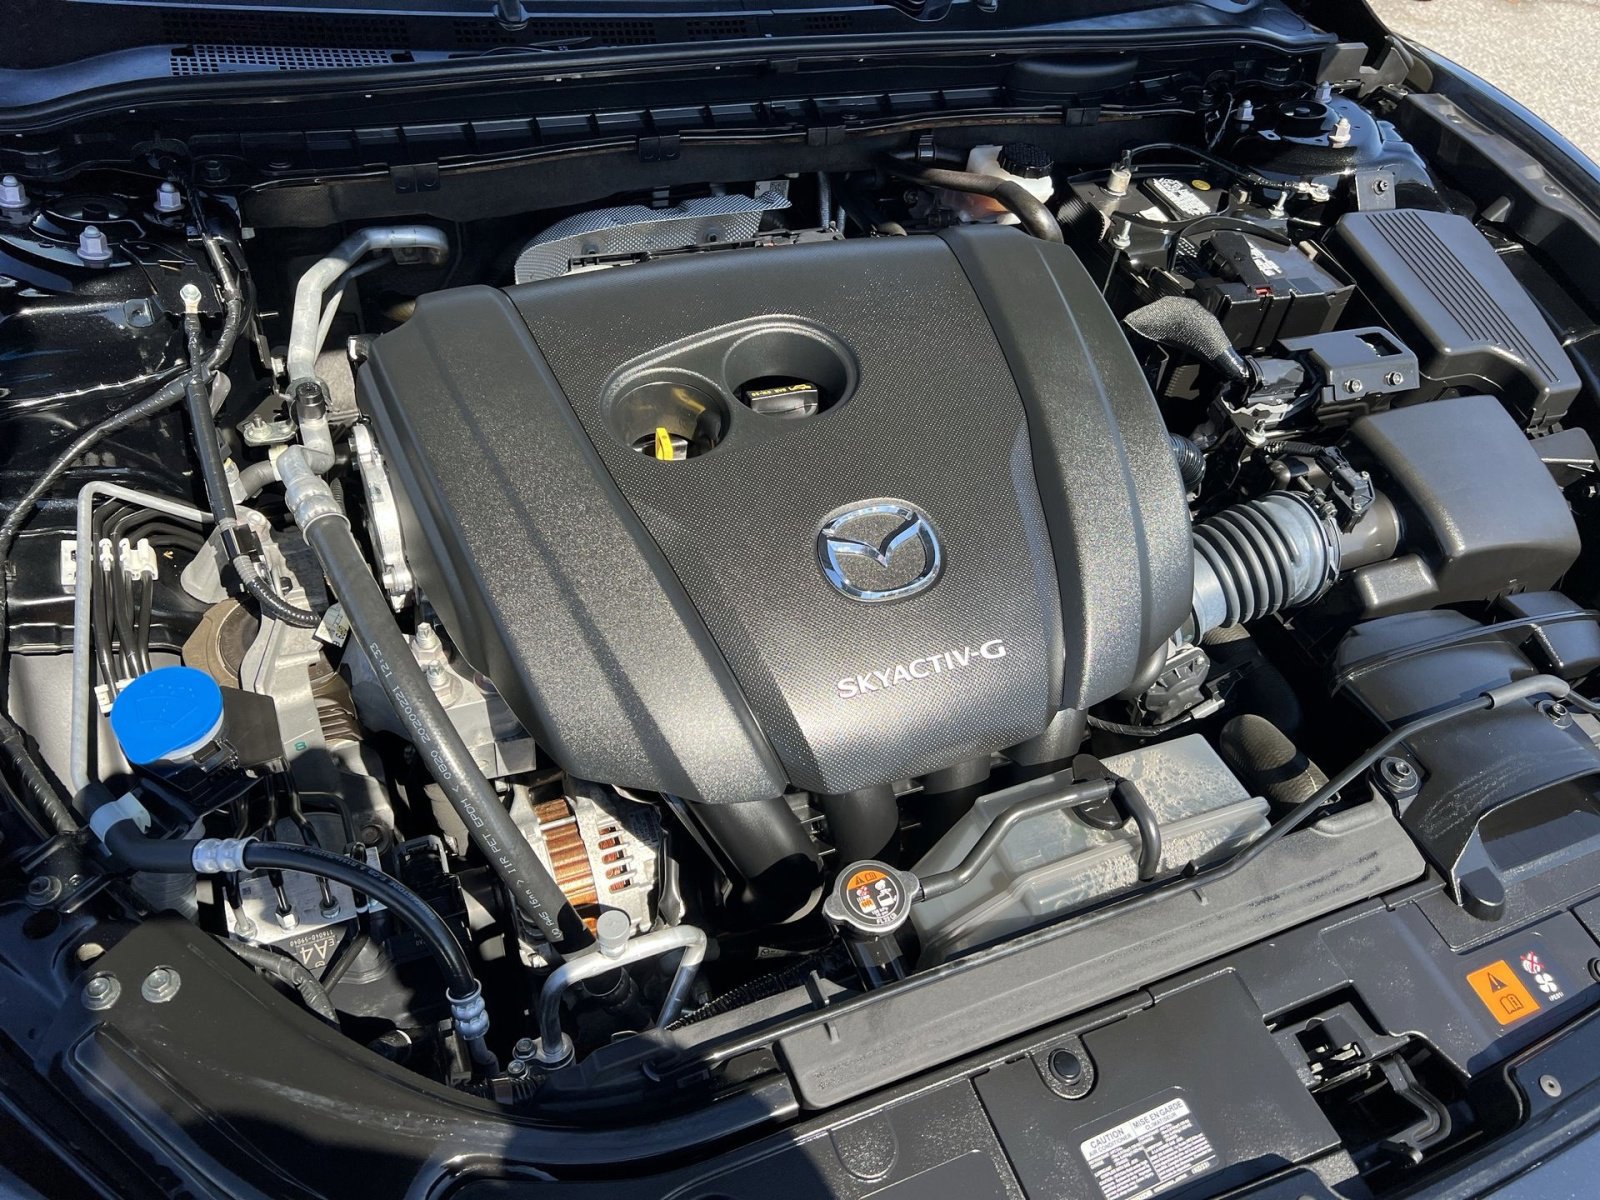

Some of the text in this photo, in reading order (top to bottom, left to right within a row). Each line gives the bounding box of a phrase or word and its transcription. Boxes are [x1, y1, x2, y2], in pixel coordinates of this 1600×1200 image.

[369, 642, 393, 678] 12:33
[837, 639, 1007, 698] SKYACTIV-G
[392, 685, 431, 744] 20200221
[460, 798, 485, 828] EPDM
[482, 833, 501, 854] PET
[300, 940, 329, 964] A4
[1132, 1101, 1184, 1129] MISE EN GARDE
[1090, 1128, 1125, 1149] CAUTION
